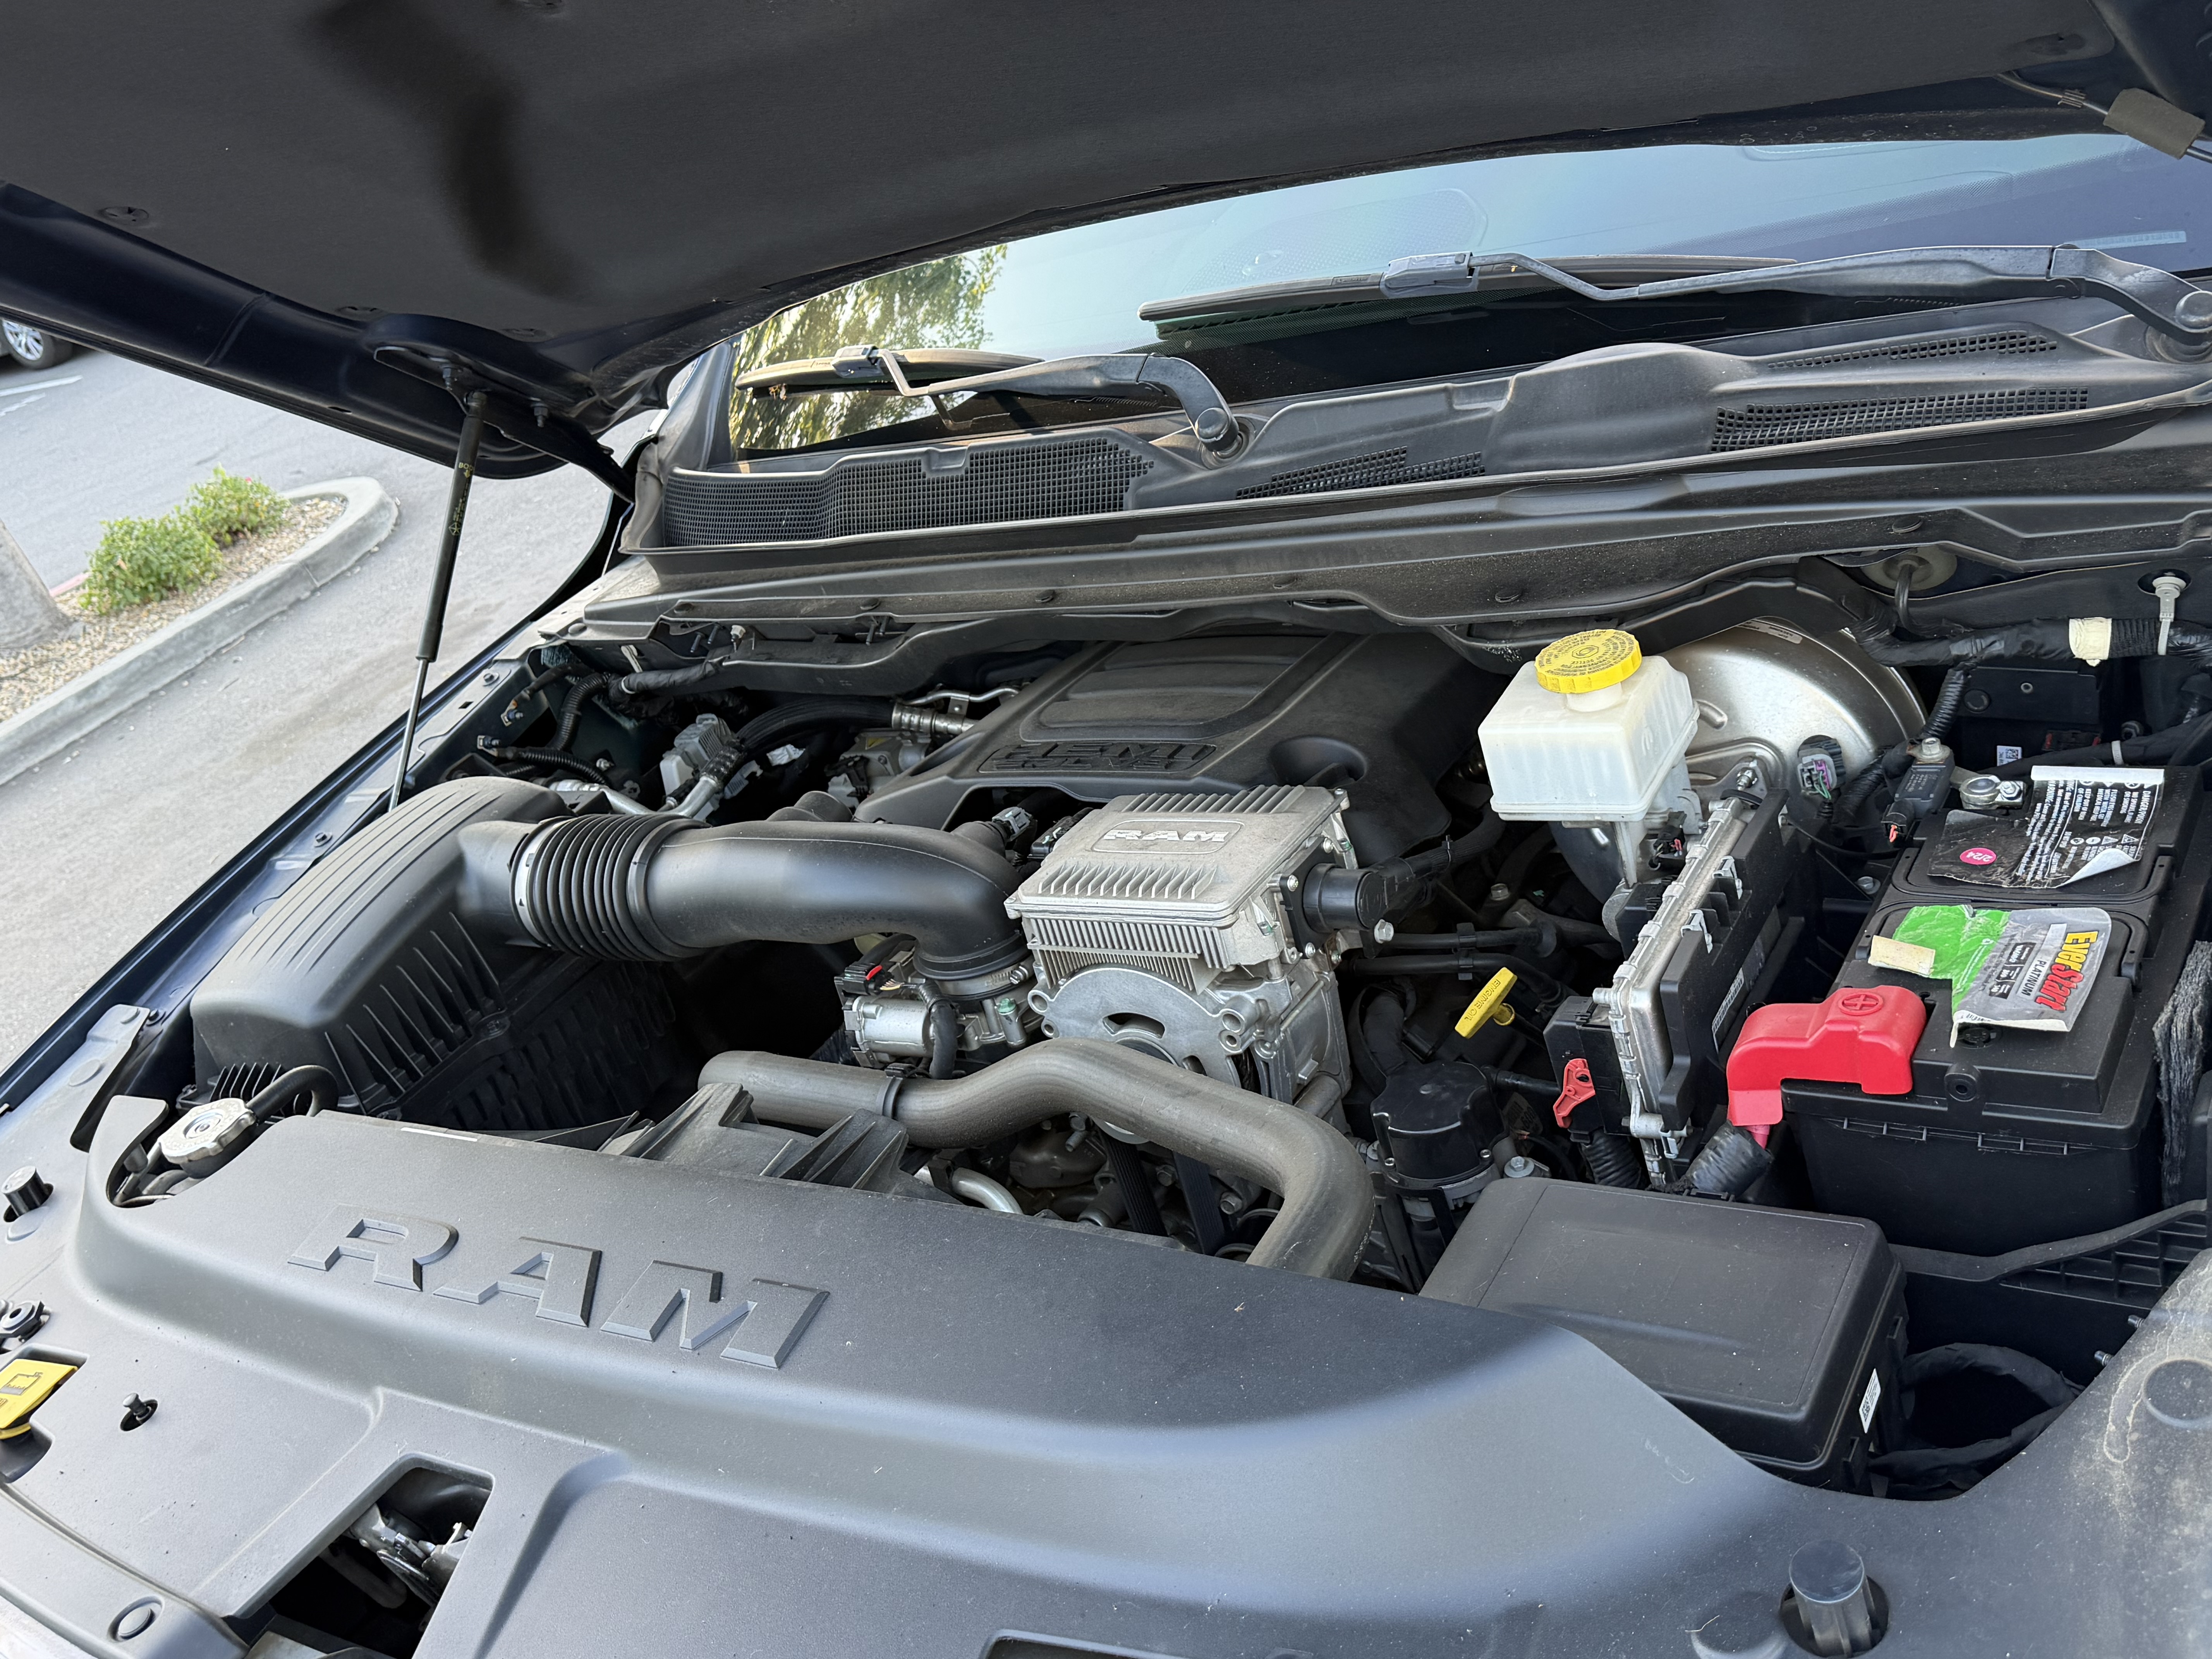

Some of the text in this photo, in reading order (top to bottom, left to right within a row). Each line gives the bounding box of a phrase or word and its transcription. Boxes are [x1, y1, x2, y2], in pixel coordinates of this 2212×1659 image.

[1103, 829, 1229, 842] RAM
[1966, 851, 1993, 862] 2/24
[2021, 960, 2047, 996] PLATINUM
[2035, 931, 2098, 1011] EverStart
[1464, 979, 1501, 1021] ENGINE OIL
[287, 1204, 830, 1369] RAM
